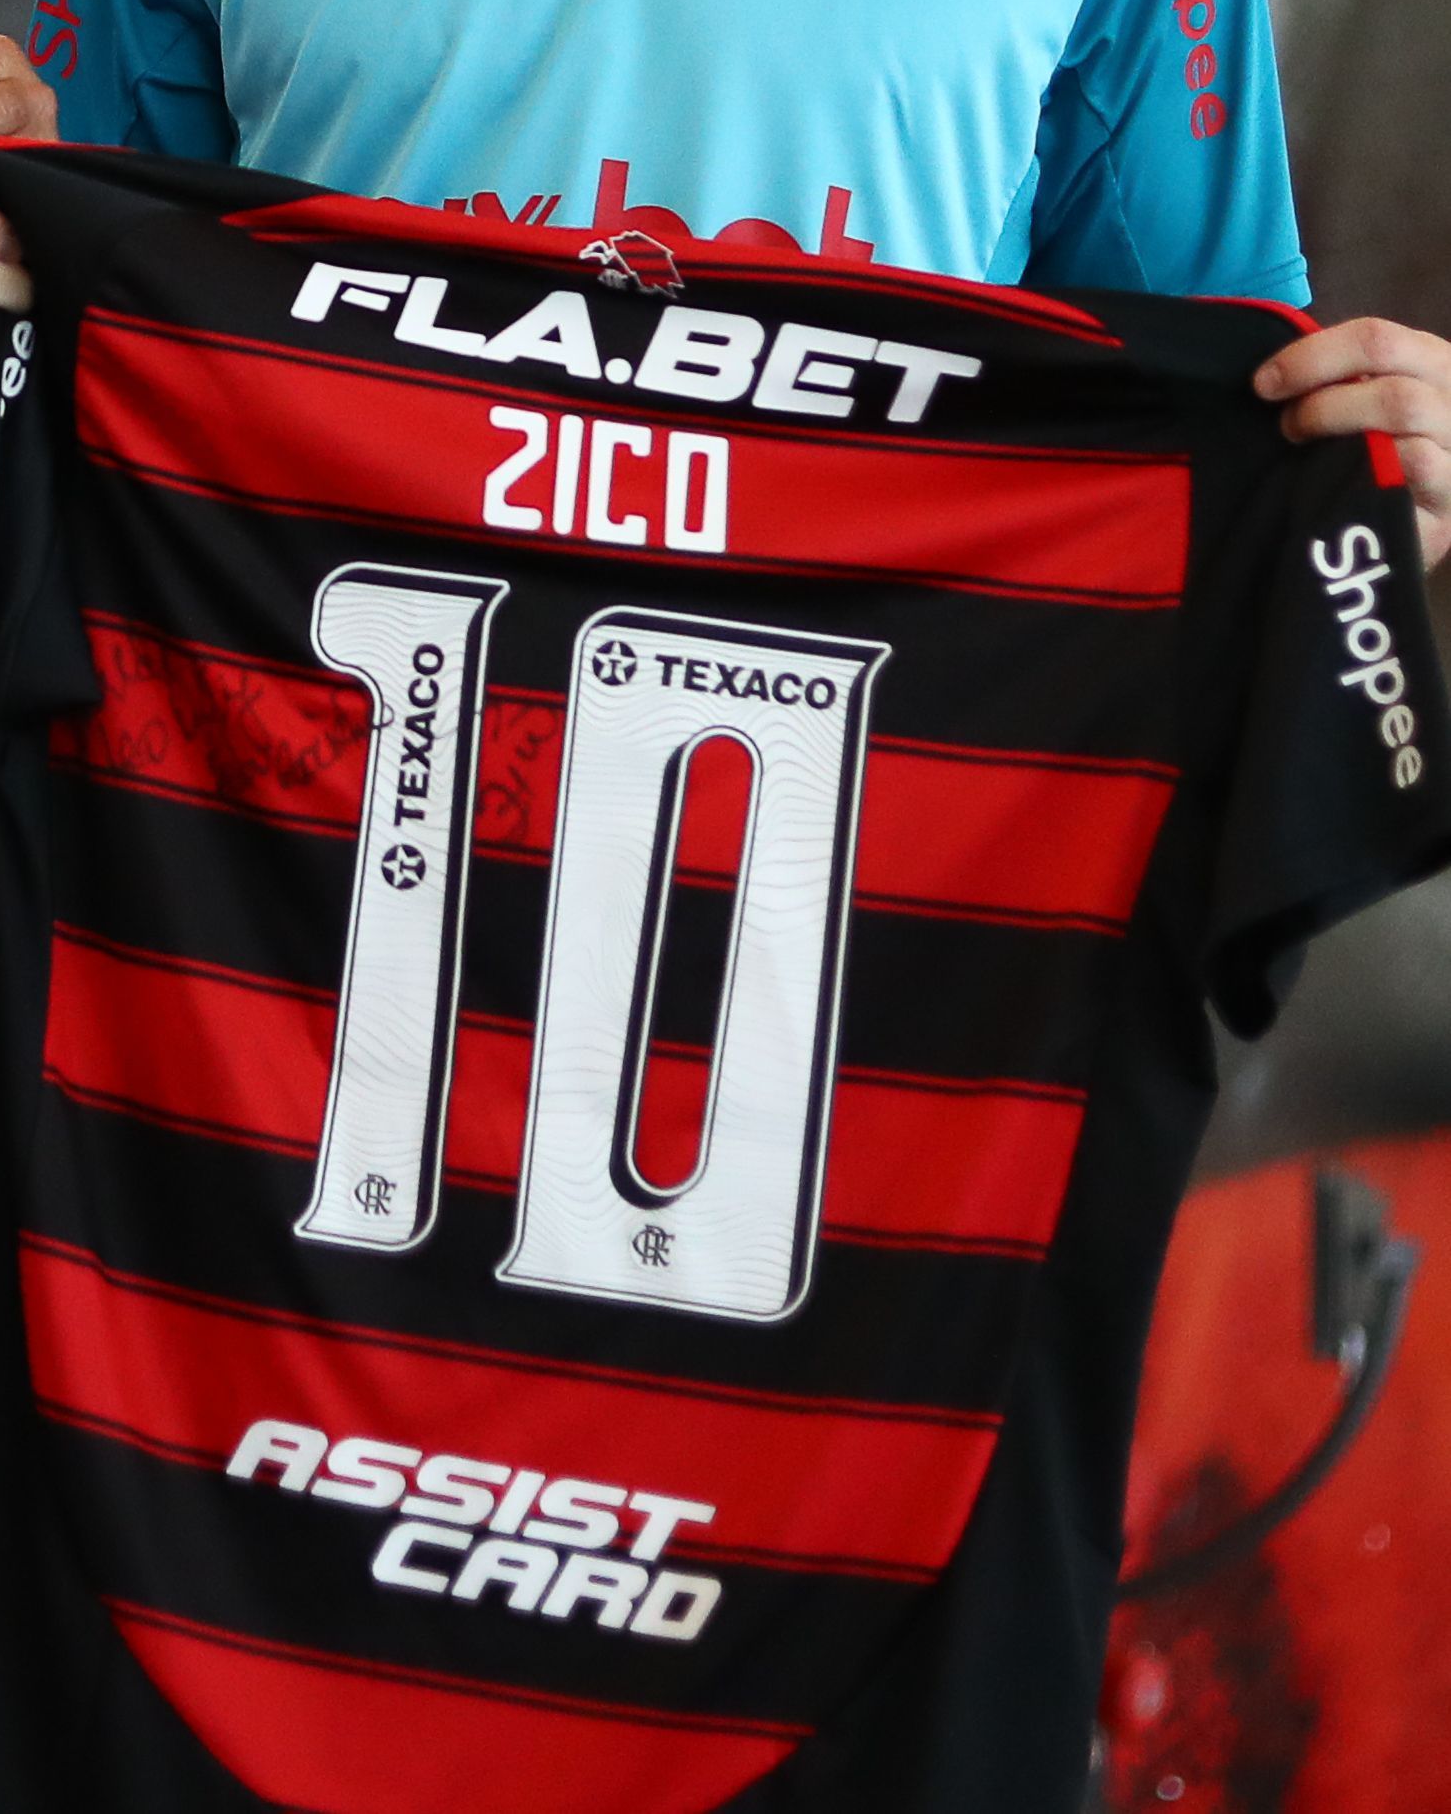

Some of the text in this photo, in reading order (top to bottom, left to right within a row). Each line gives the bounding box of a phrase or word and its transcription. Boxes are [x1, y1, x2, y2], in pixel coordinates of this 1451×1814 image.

[290, 261, 983, 424] FLA.BET
[482, 405, 730, 553] ZICO
[654, 654, 838, 711] TEXACO
[1310, 524, 1424, 789] Shopee
[394, 643, 445, 828] TEXACO
[293, 560, 893, 1323] 10
[225, 1418, 717, 1561] ASSIST
[371, 1521, 722, 1642] CARD
